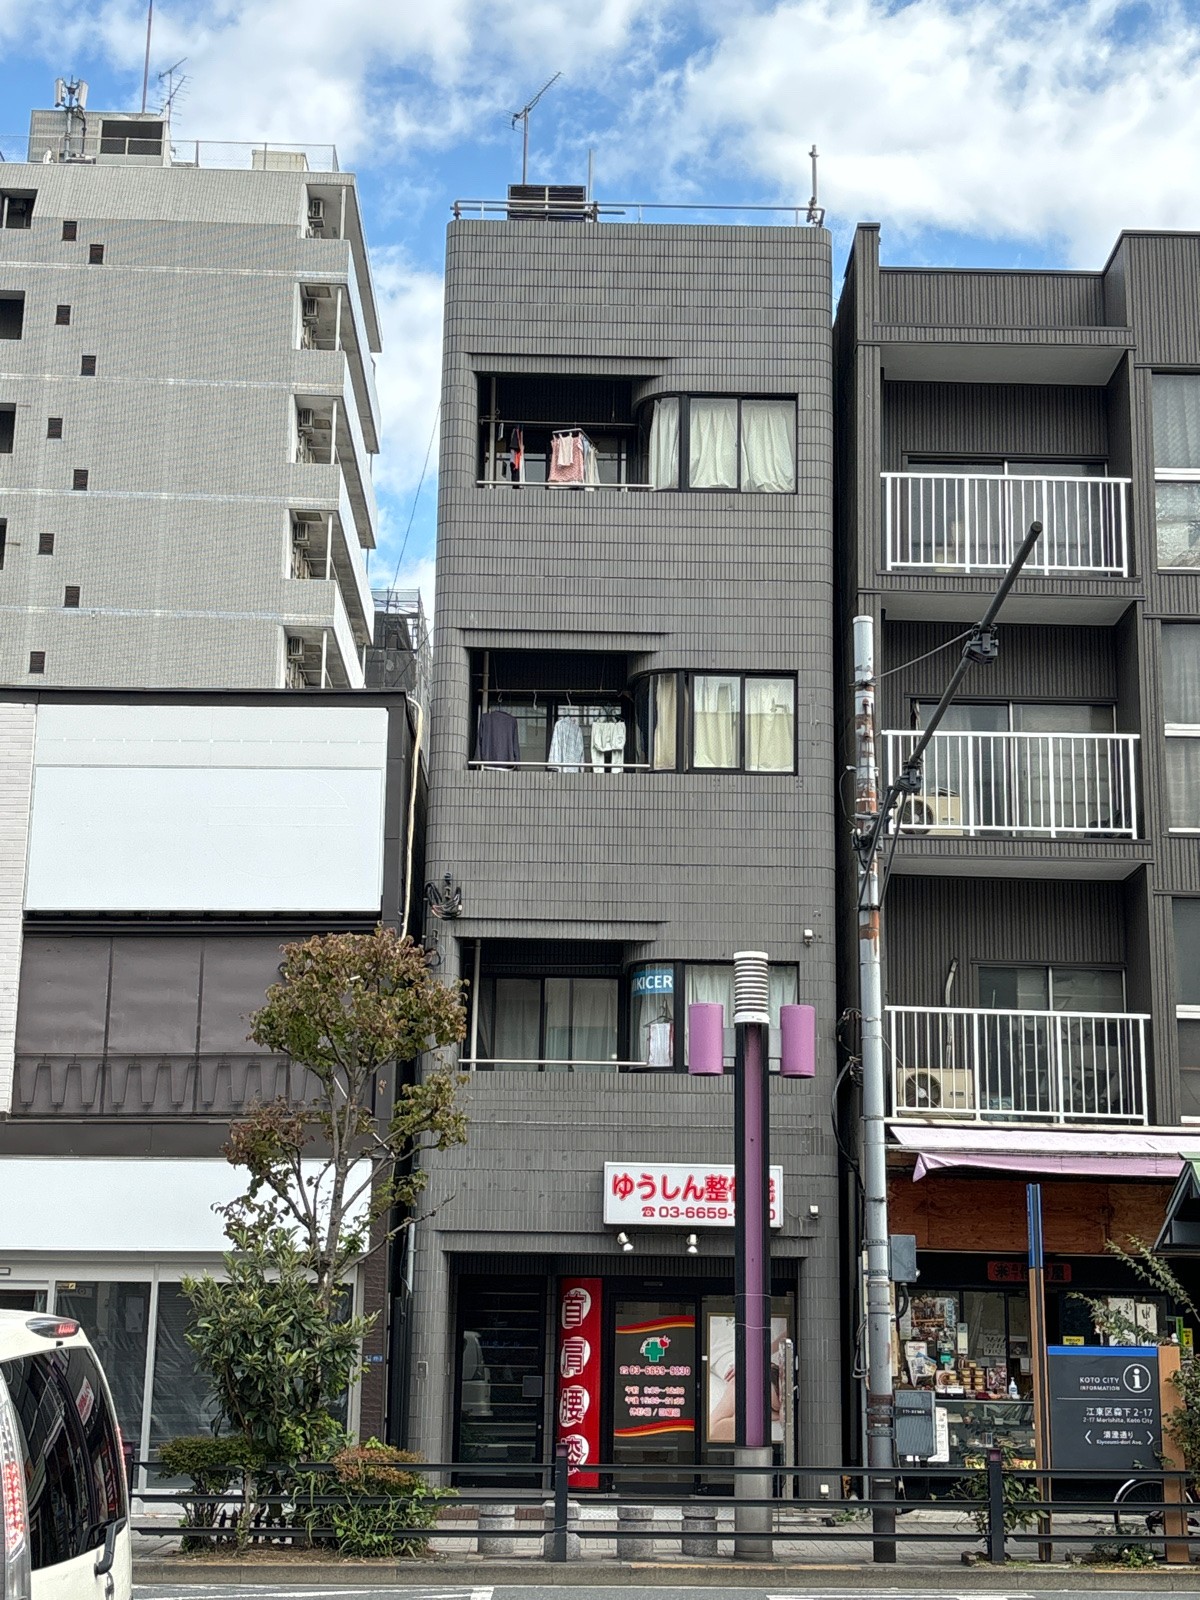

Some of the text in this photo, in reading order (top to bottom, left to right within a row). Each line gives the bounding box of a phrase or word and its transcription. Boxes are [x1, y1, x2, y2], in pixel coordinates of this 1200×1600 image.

[612, 1173, 775, 1203] ゆうしん整
[563, 1290, 587, 1327] 首
[562, 1338, 586, 1376] 肩
[561, 1387, 585, 1424] 腰
[1086, 1407, 1153, 1417] 江東区森下 2-17
